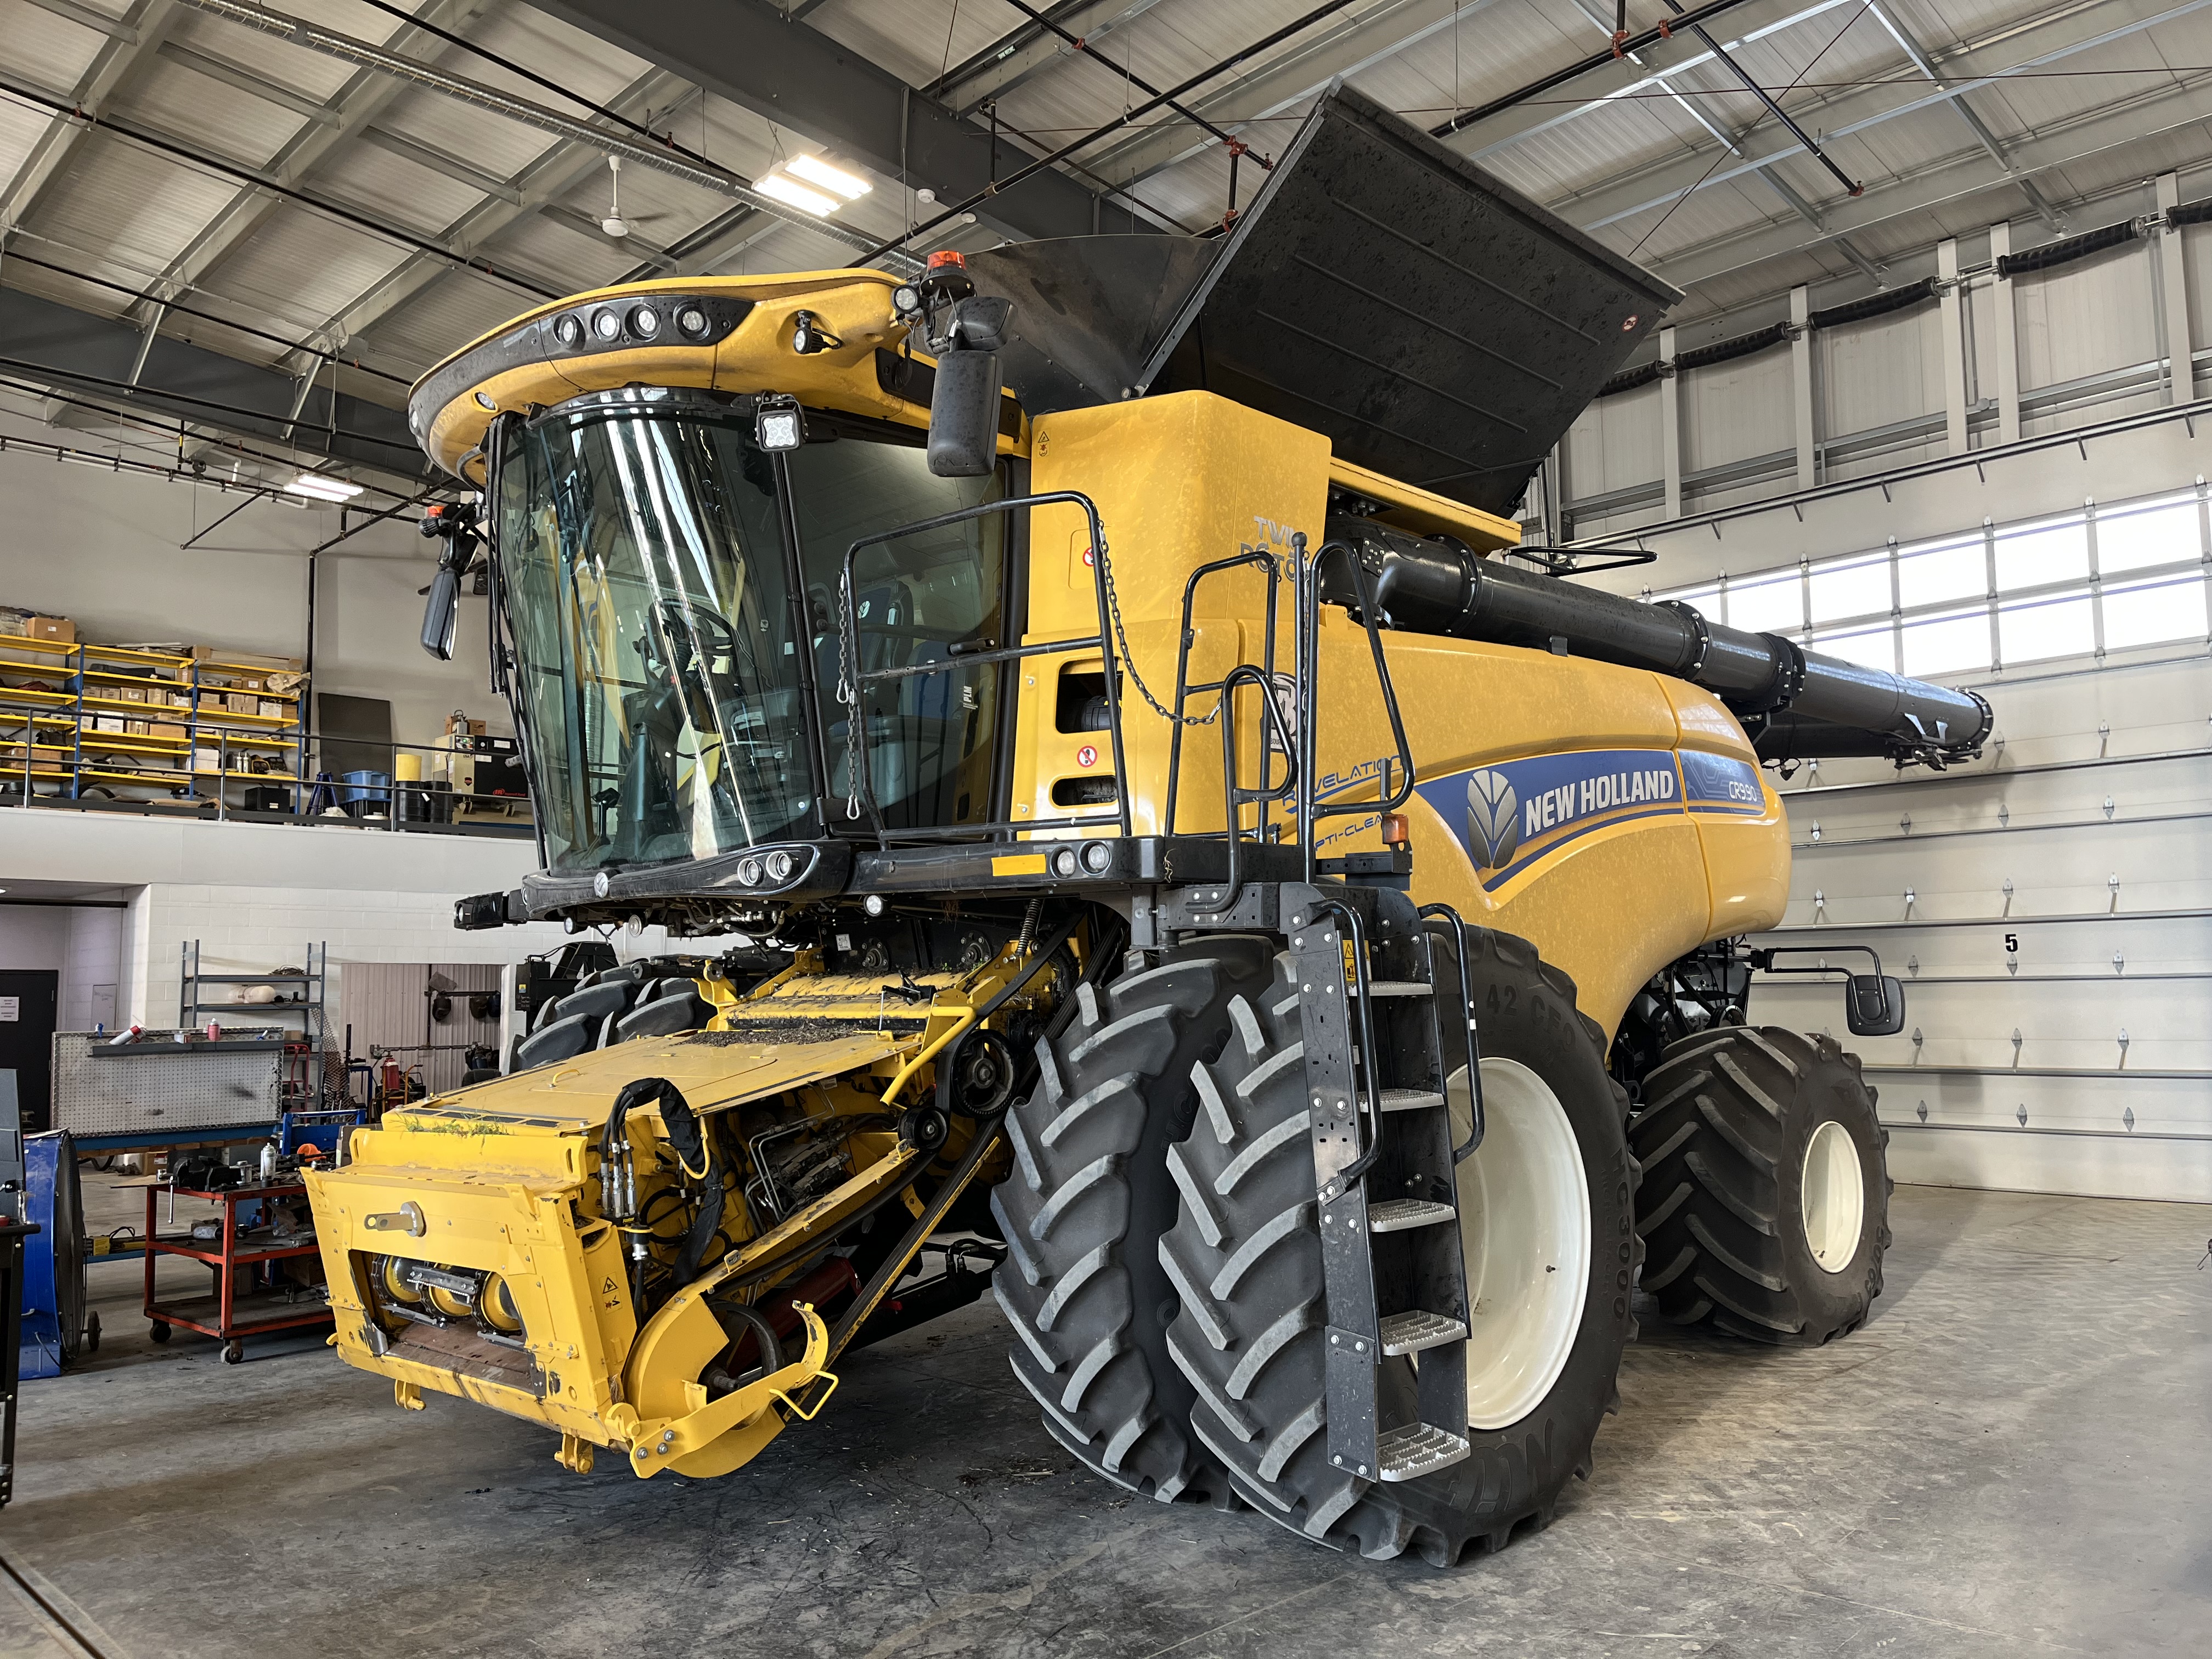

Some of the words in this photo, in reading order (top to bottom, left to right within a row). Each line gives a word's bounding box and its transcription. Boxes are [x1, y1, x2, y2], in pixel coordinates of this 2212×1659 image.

[1282, 754, 1403, 806] RVELATIN
[1729, 781, 1757, 802] CR9.90
[1526, 782, 1576, 837] NEW
[1581, 770, 1674, 814] HOLLAND
[1315, 814, 1383, 851] PTI-CLEA
[2005, 934, 2018, 952] 5
[1486, 984, 1518, 1016] 42
